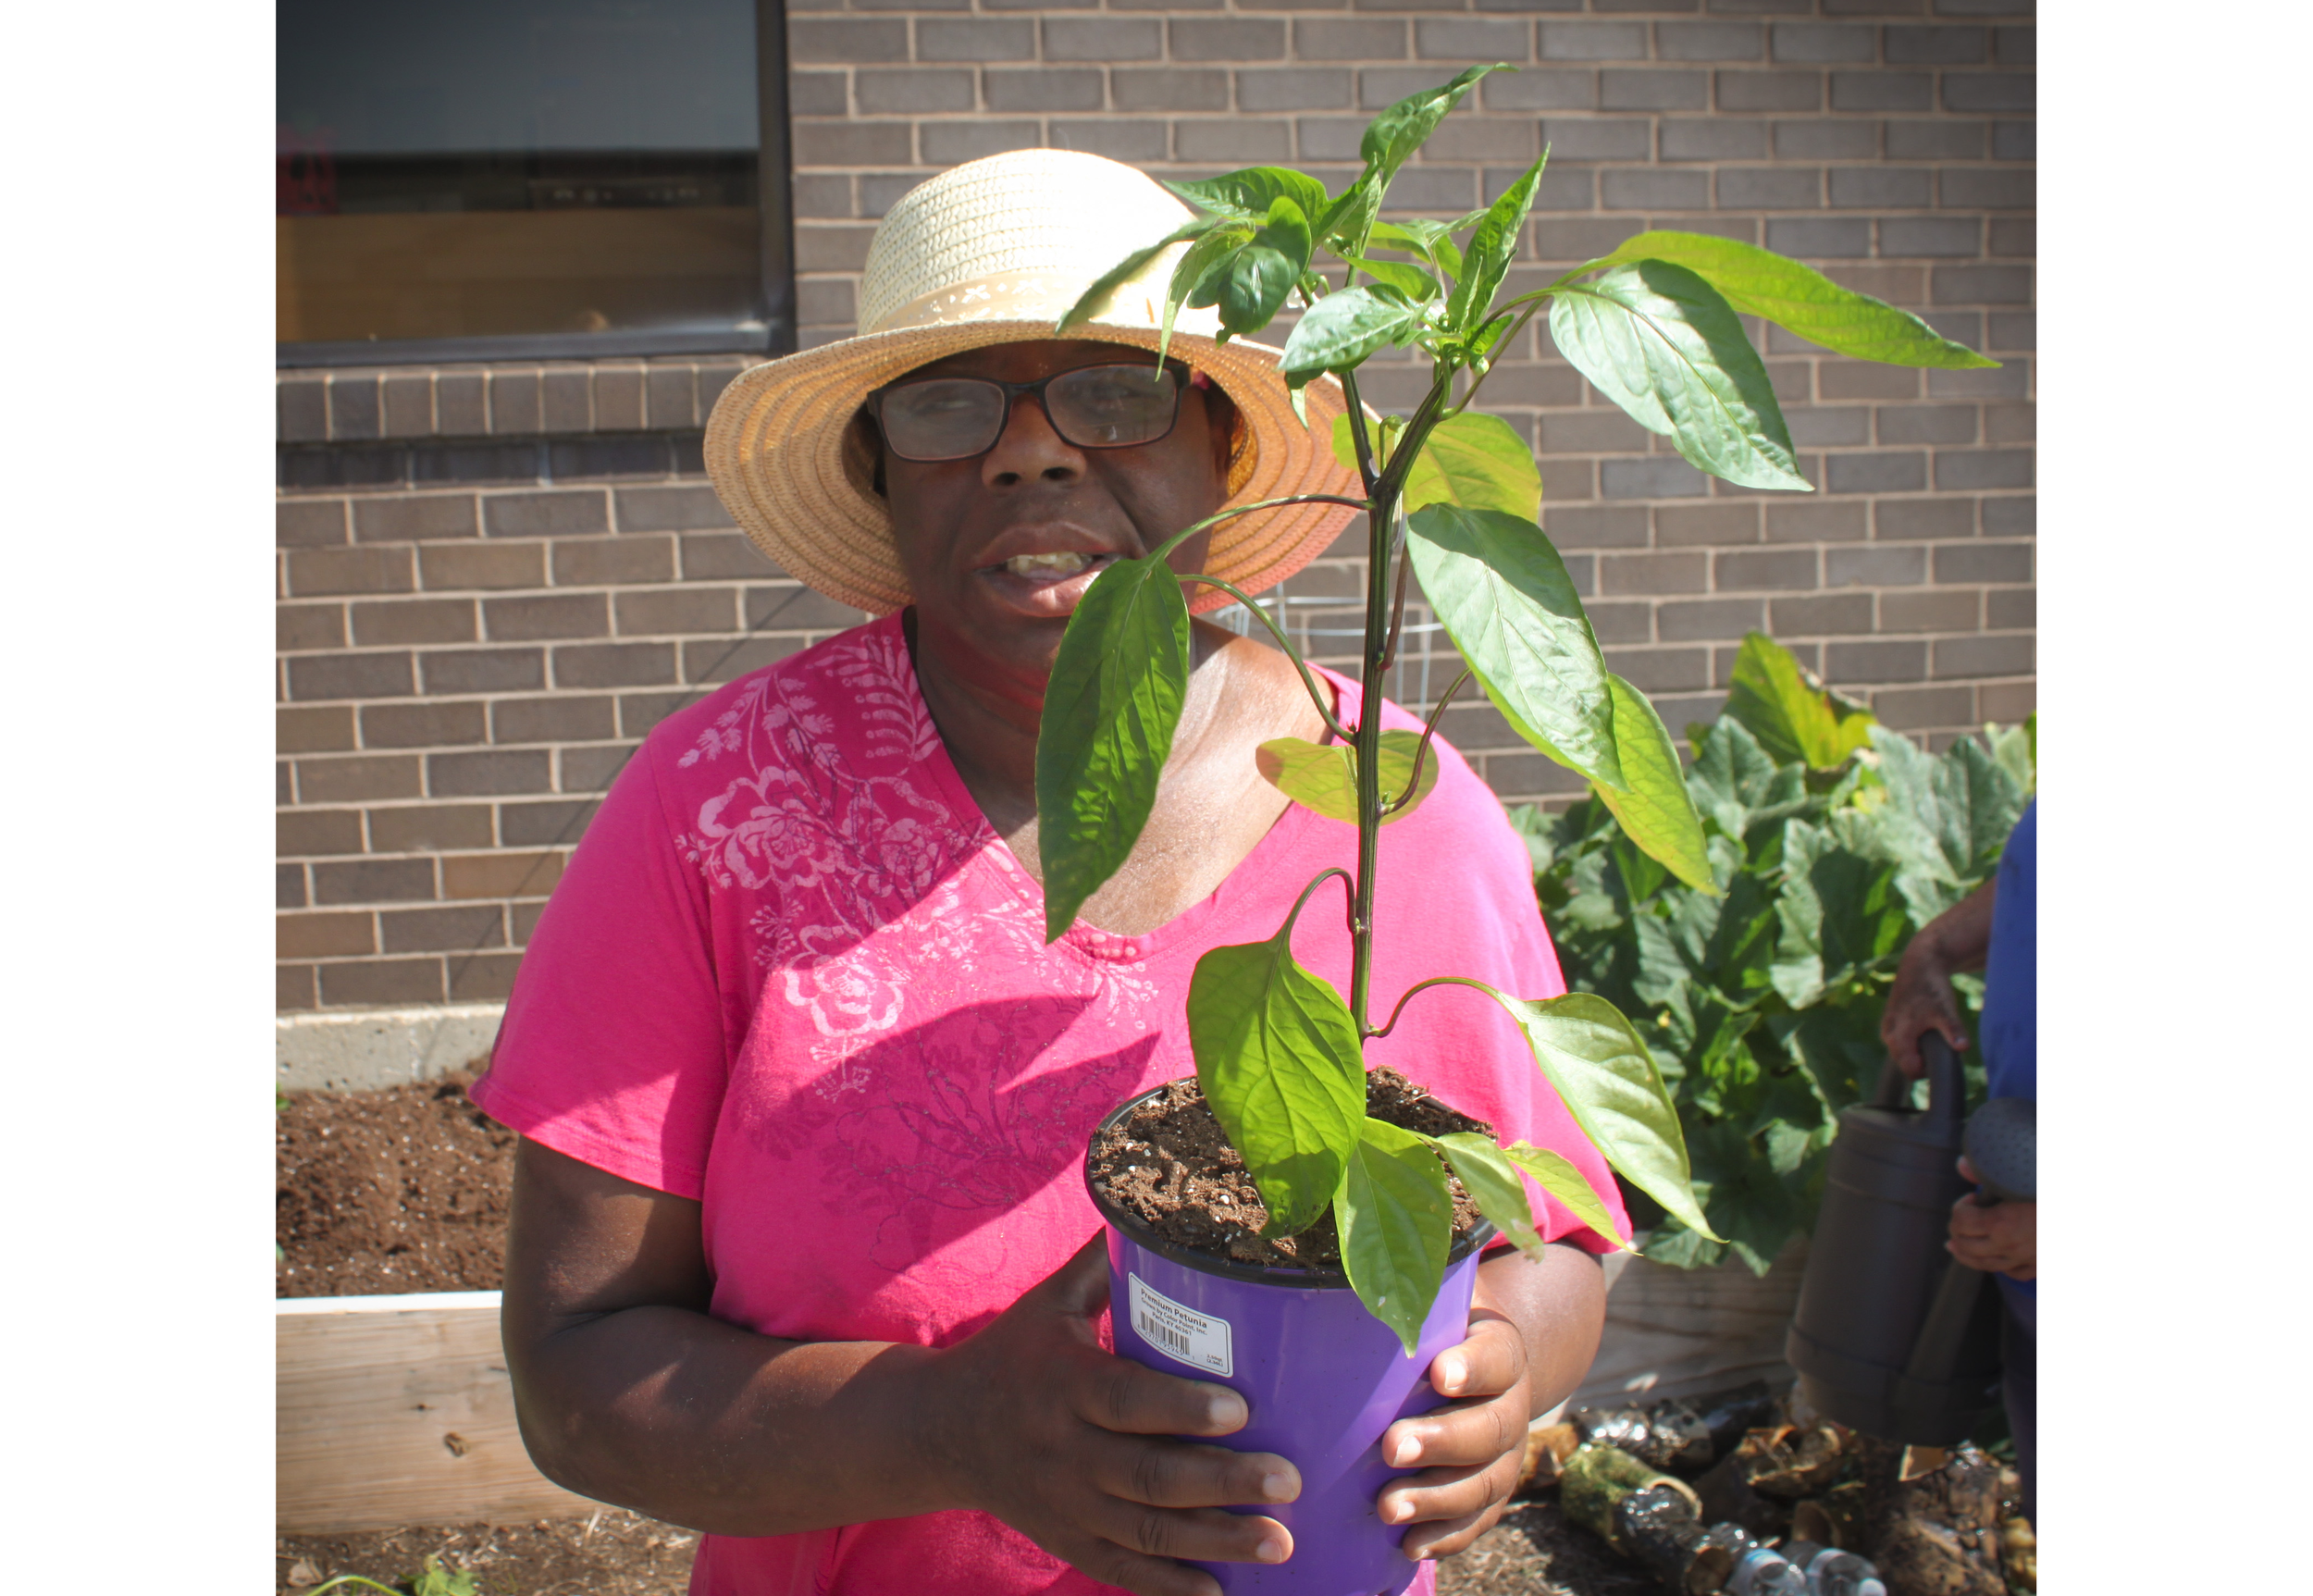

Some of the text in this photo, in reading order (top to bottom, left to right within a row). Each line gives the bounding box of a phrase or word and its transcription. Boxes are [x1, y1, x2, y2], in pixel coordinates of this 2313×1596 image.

[1141, 1288, 1207, 1329] Premium Petunia
[1164, 1312, 1179, 1323] Color
[1196, 1327, 1208, 1336] Inc.
